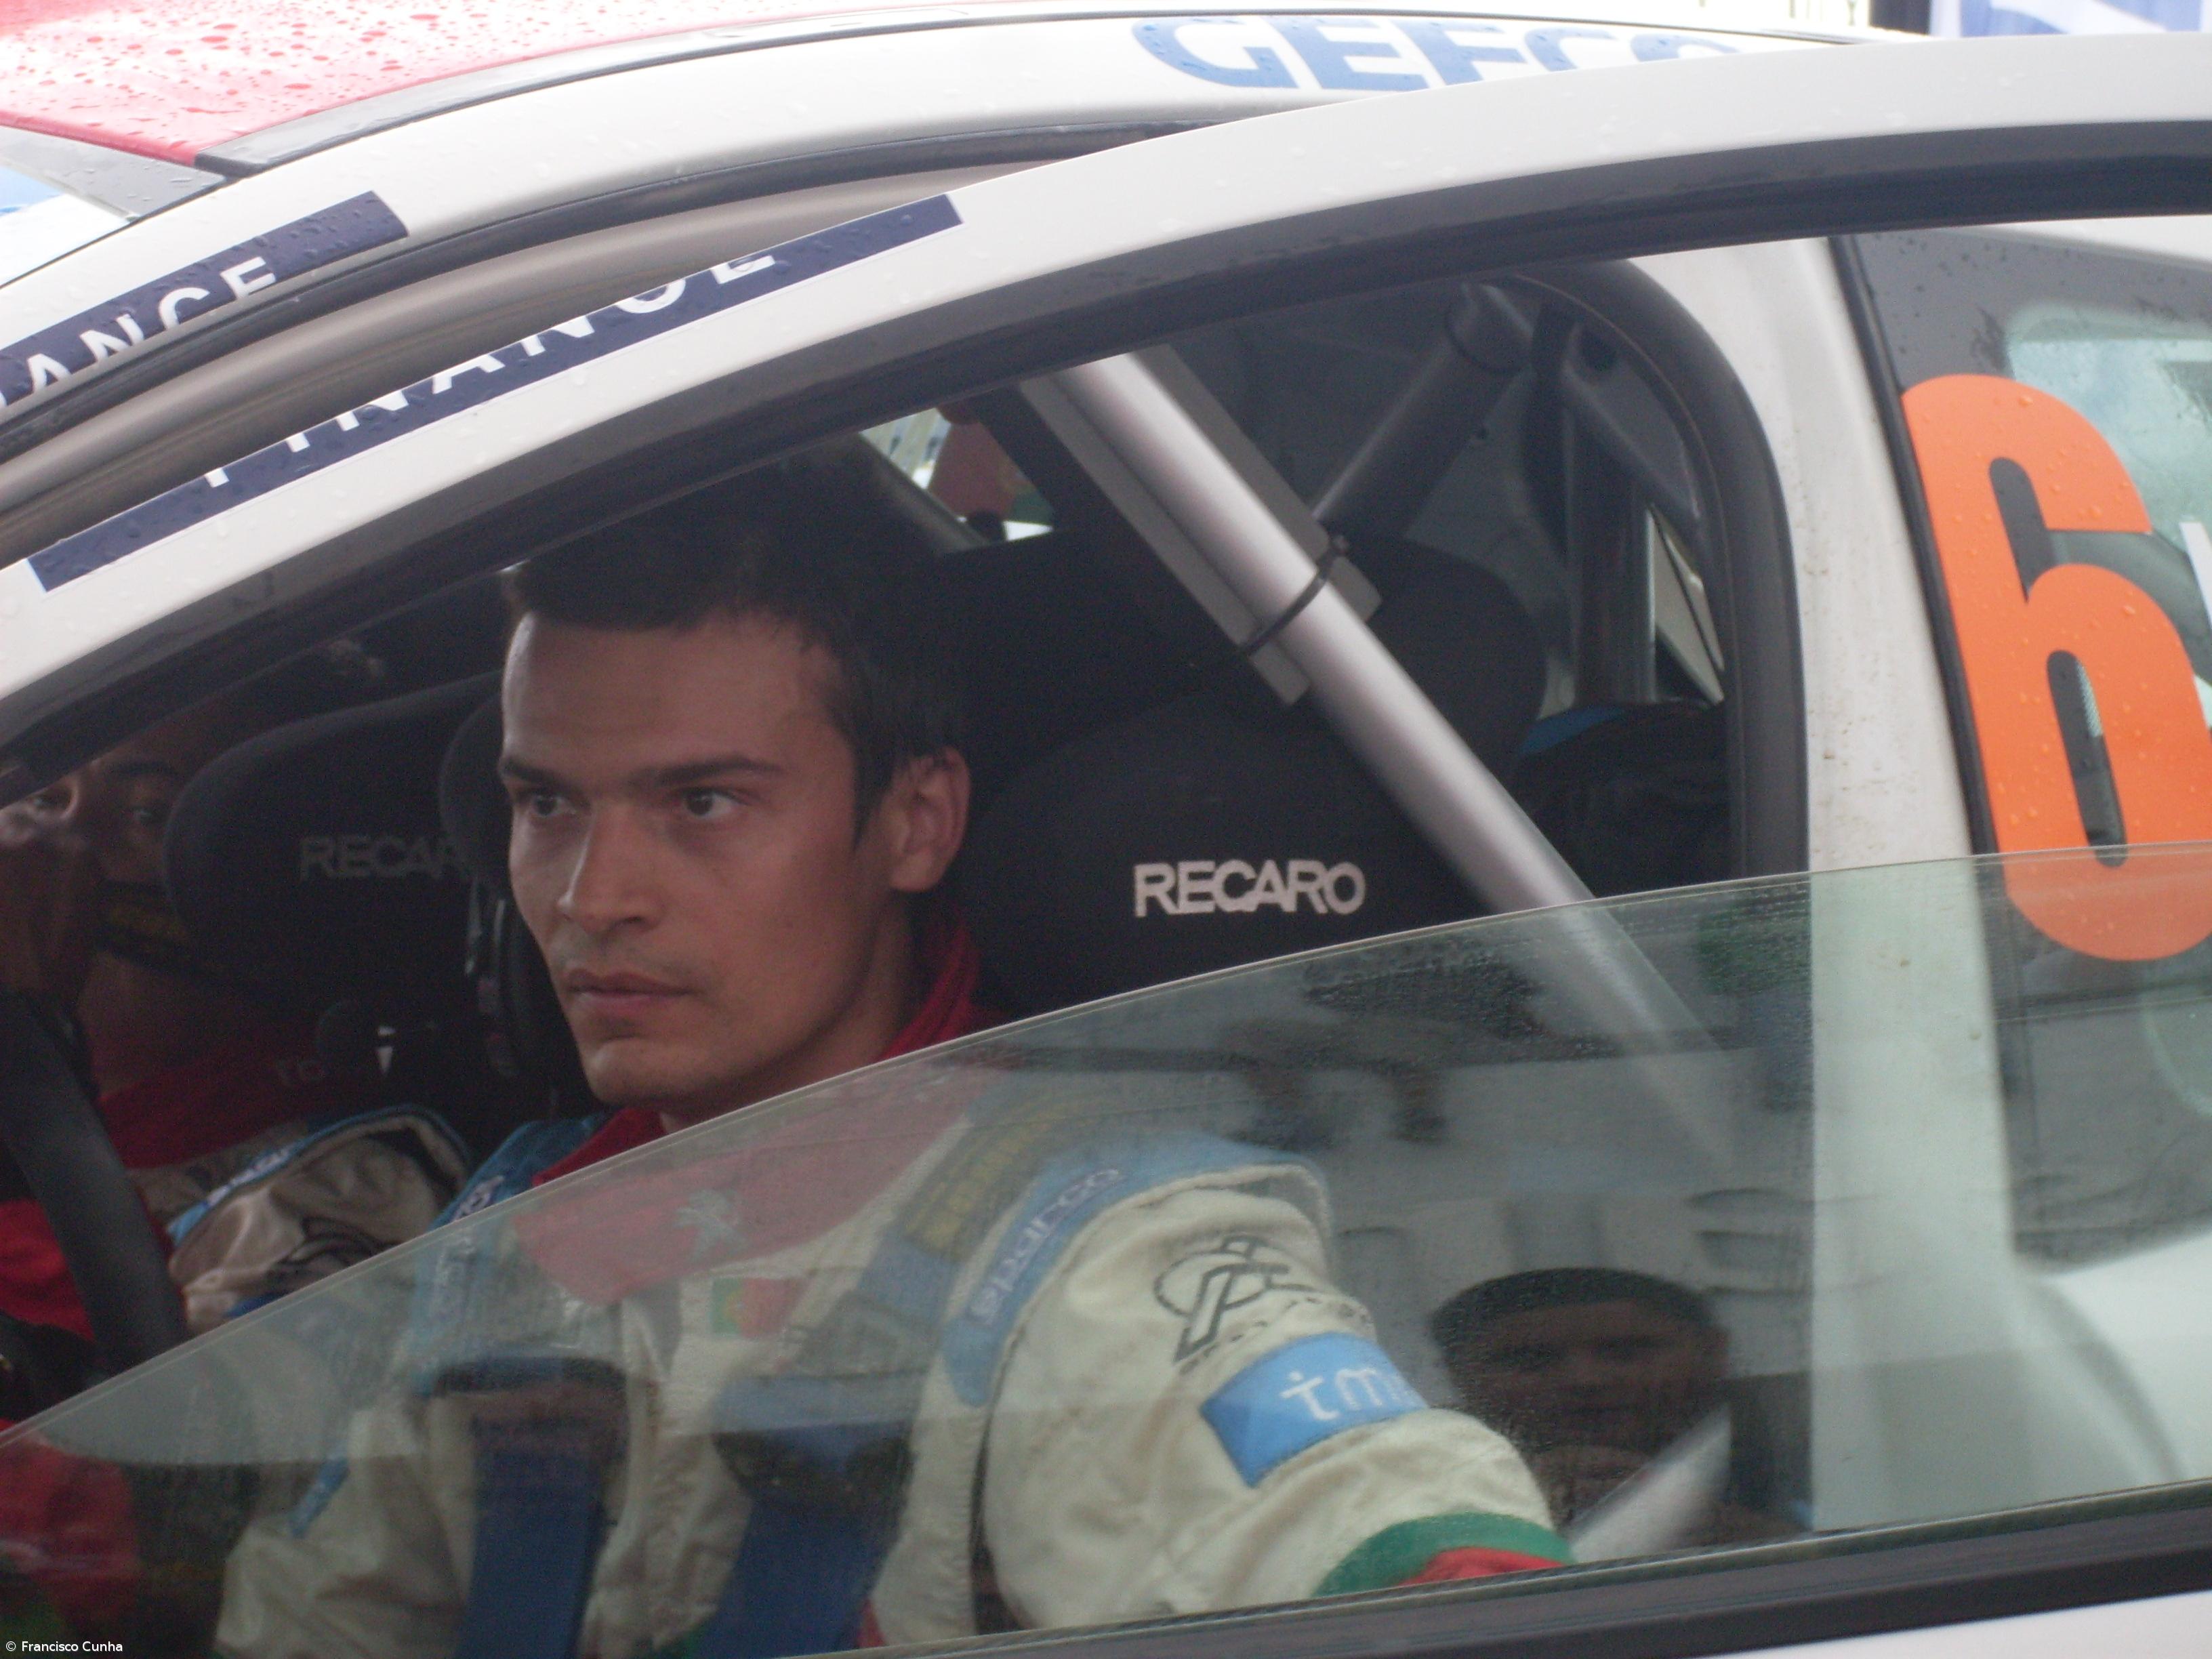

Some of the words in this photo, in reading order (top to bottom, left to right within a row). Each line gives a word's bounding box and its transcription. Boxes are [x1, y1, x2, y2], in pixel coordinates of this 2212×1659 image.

[0, 256, 276, 407] ANCE
[1901, 373, 2212, 961] 6
[1133, 859, 1366, 918] RECARO
